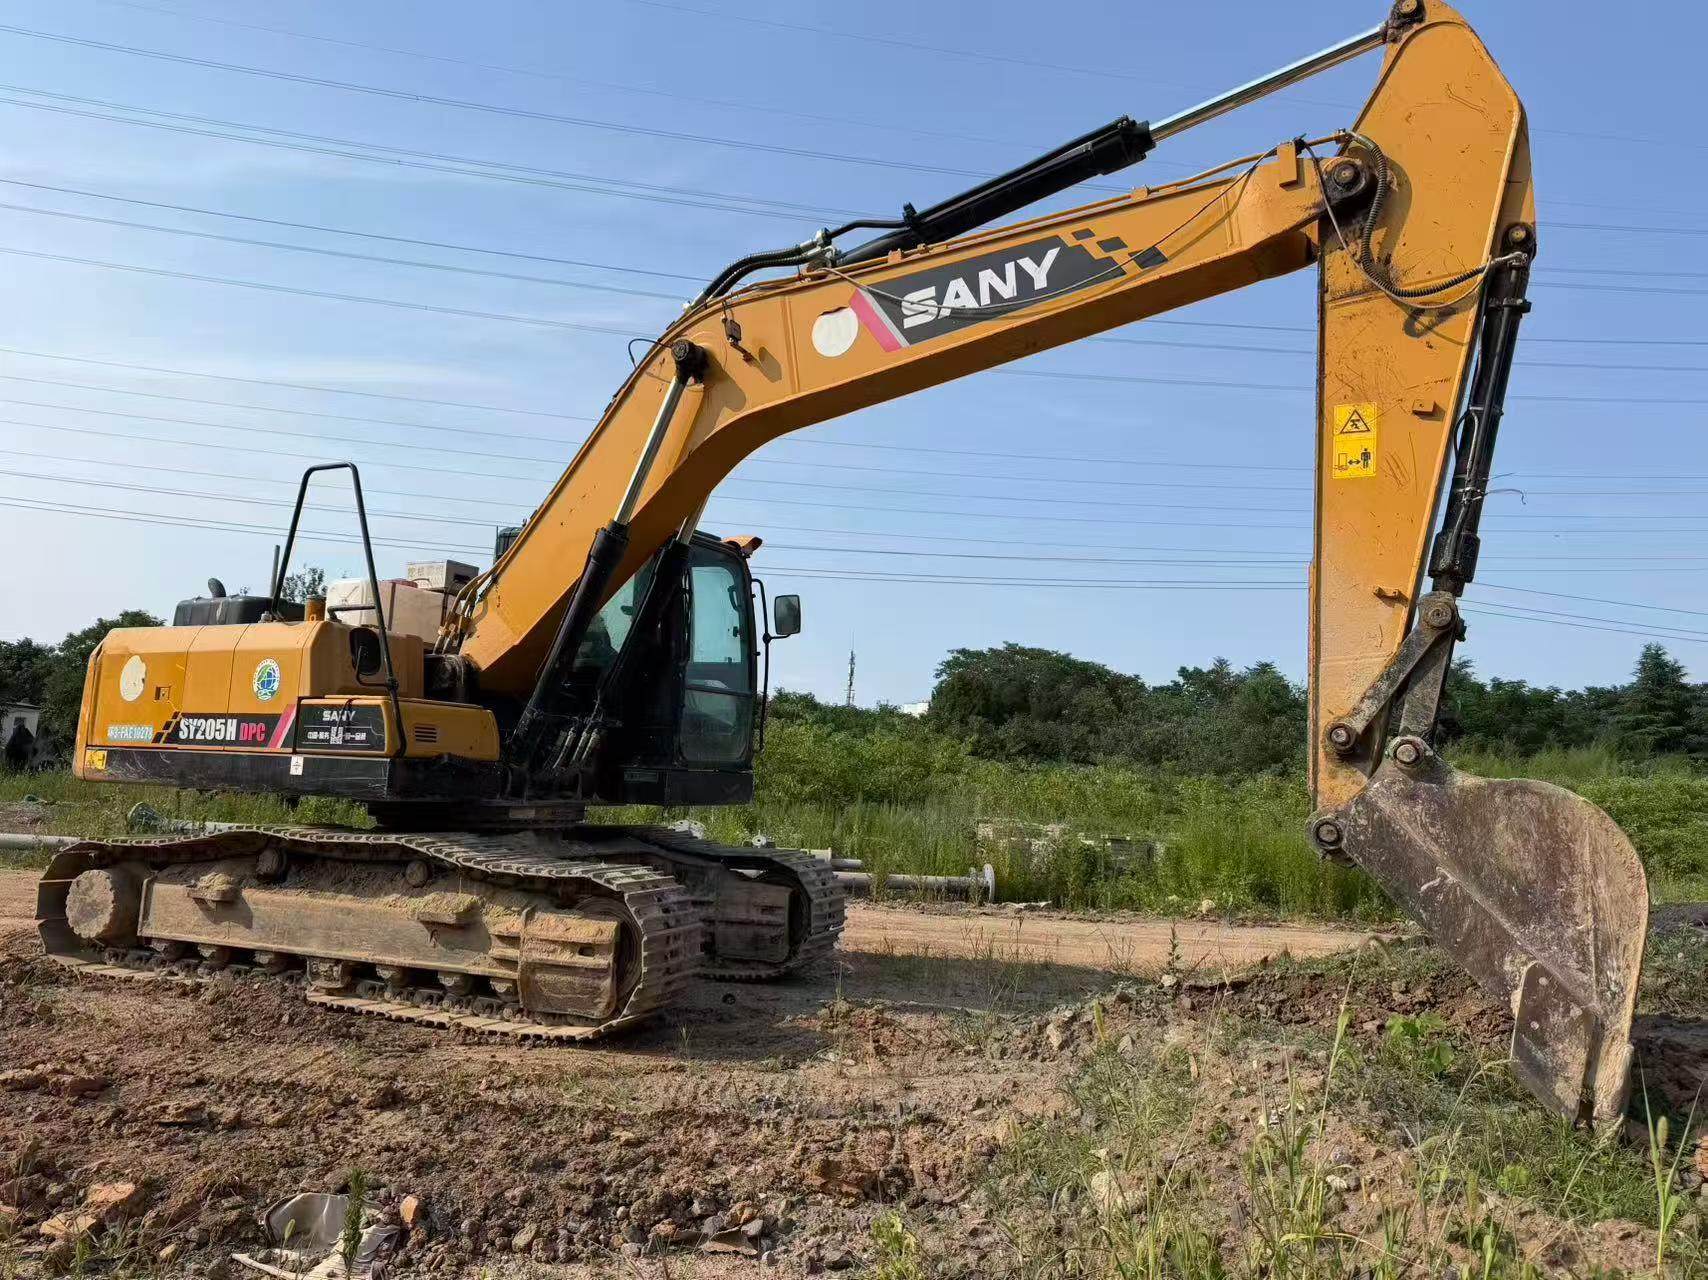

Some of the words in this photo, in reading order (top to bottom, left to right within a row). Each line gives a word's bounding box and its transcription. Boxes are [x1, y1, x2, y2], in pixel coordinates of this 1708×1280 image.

[901, 247, 1061, 329] SANY
[322, 710, 356, 722] SANY
[178, 718, 238, 741] SY205H
[239, 722, 266, 742] DPC
